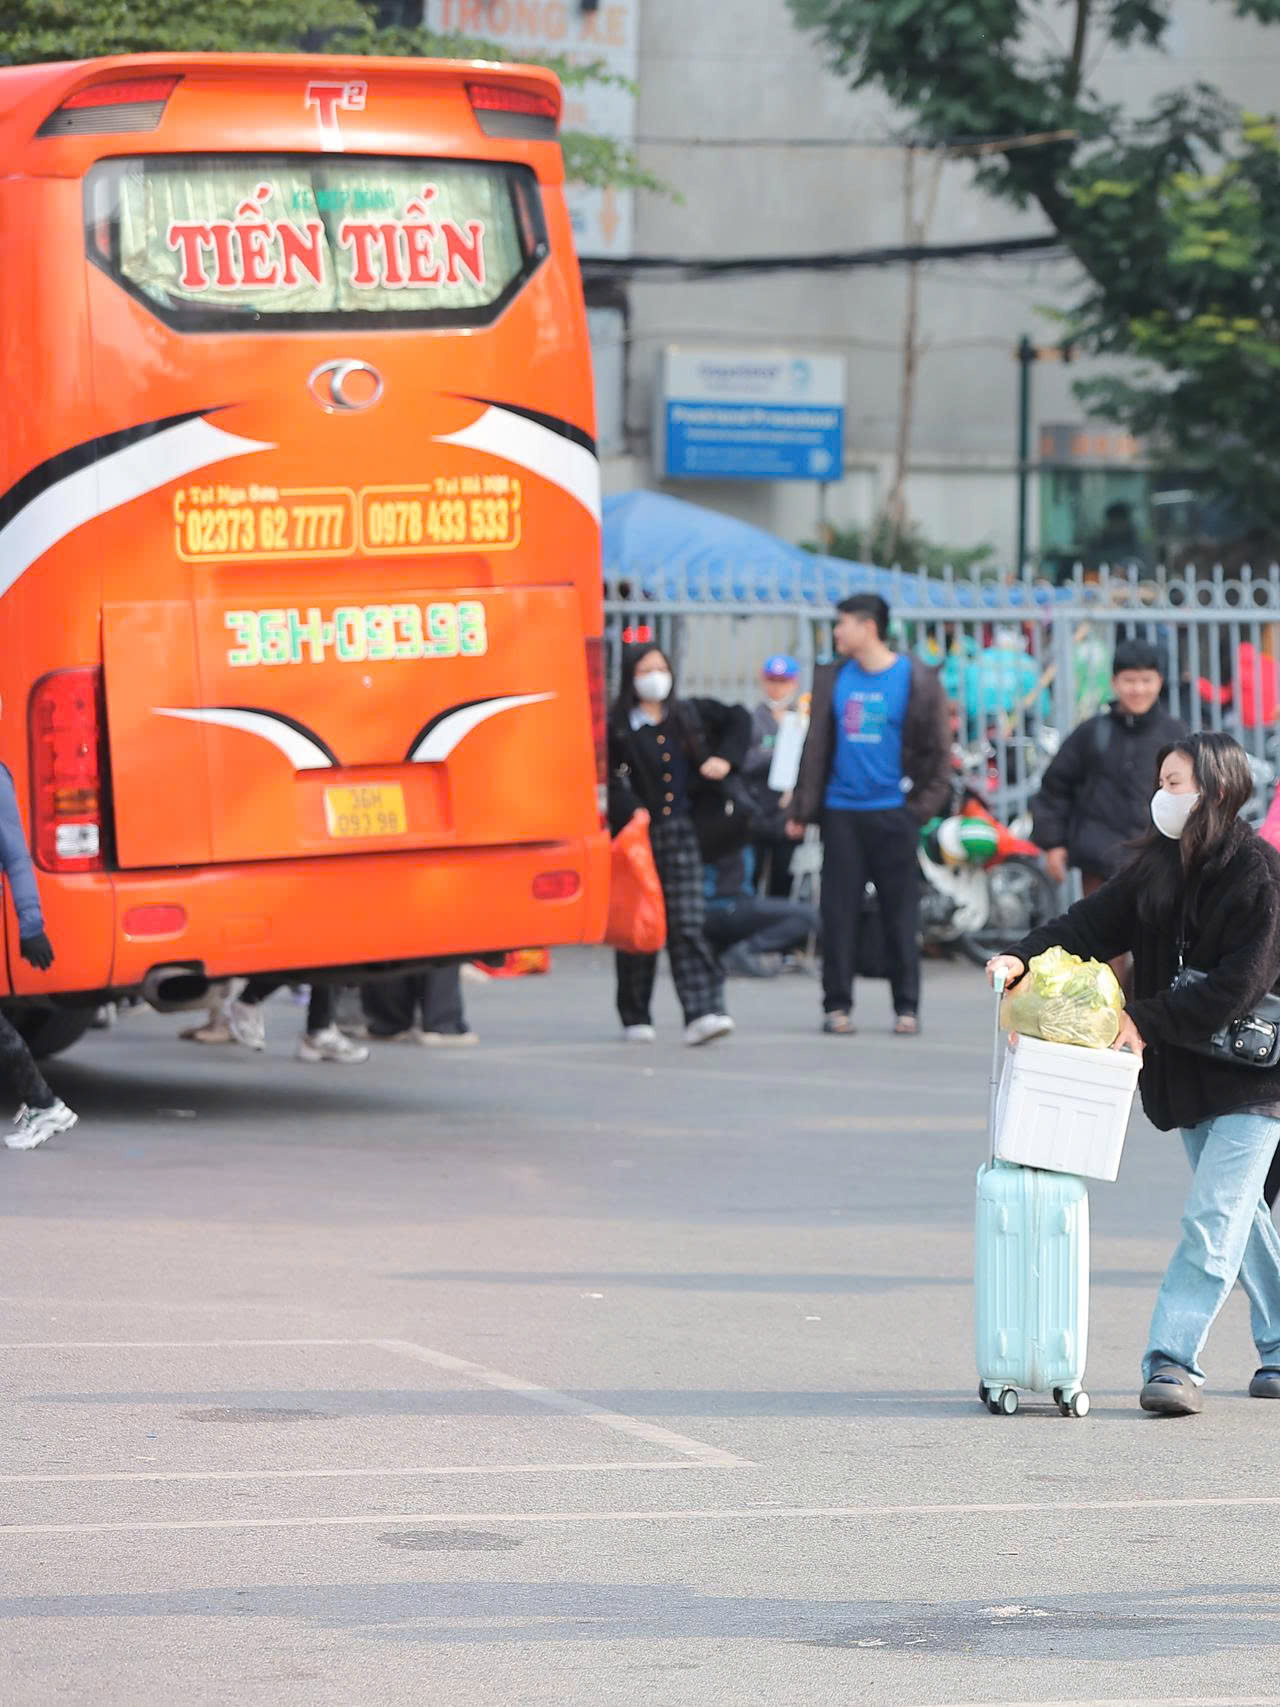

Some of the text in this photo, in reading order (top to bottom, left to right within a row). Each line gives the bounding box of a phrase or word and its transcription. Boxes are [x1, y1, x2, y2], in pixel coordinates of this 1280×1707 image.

[167, 182, 485, 290] TIẾN TIẾN
[187, 503, 346, 553] 02373 62 7777
[369, 497, 509, 545] 0978 433 533
